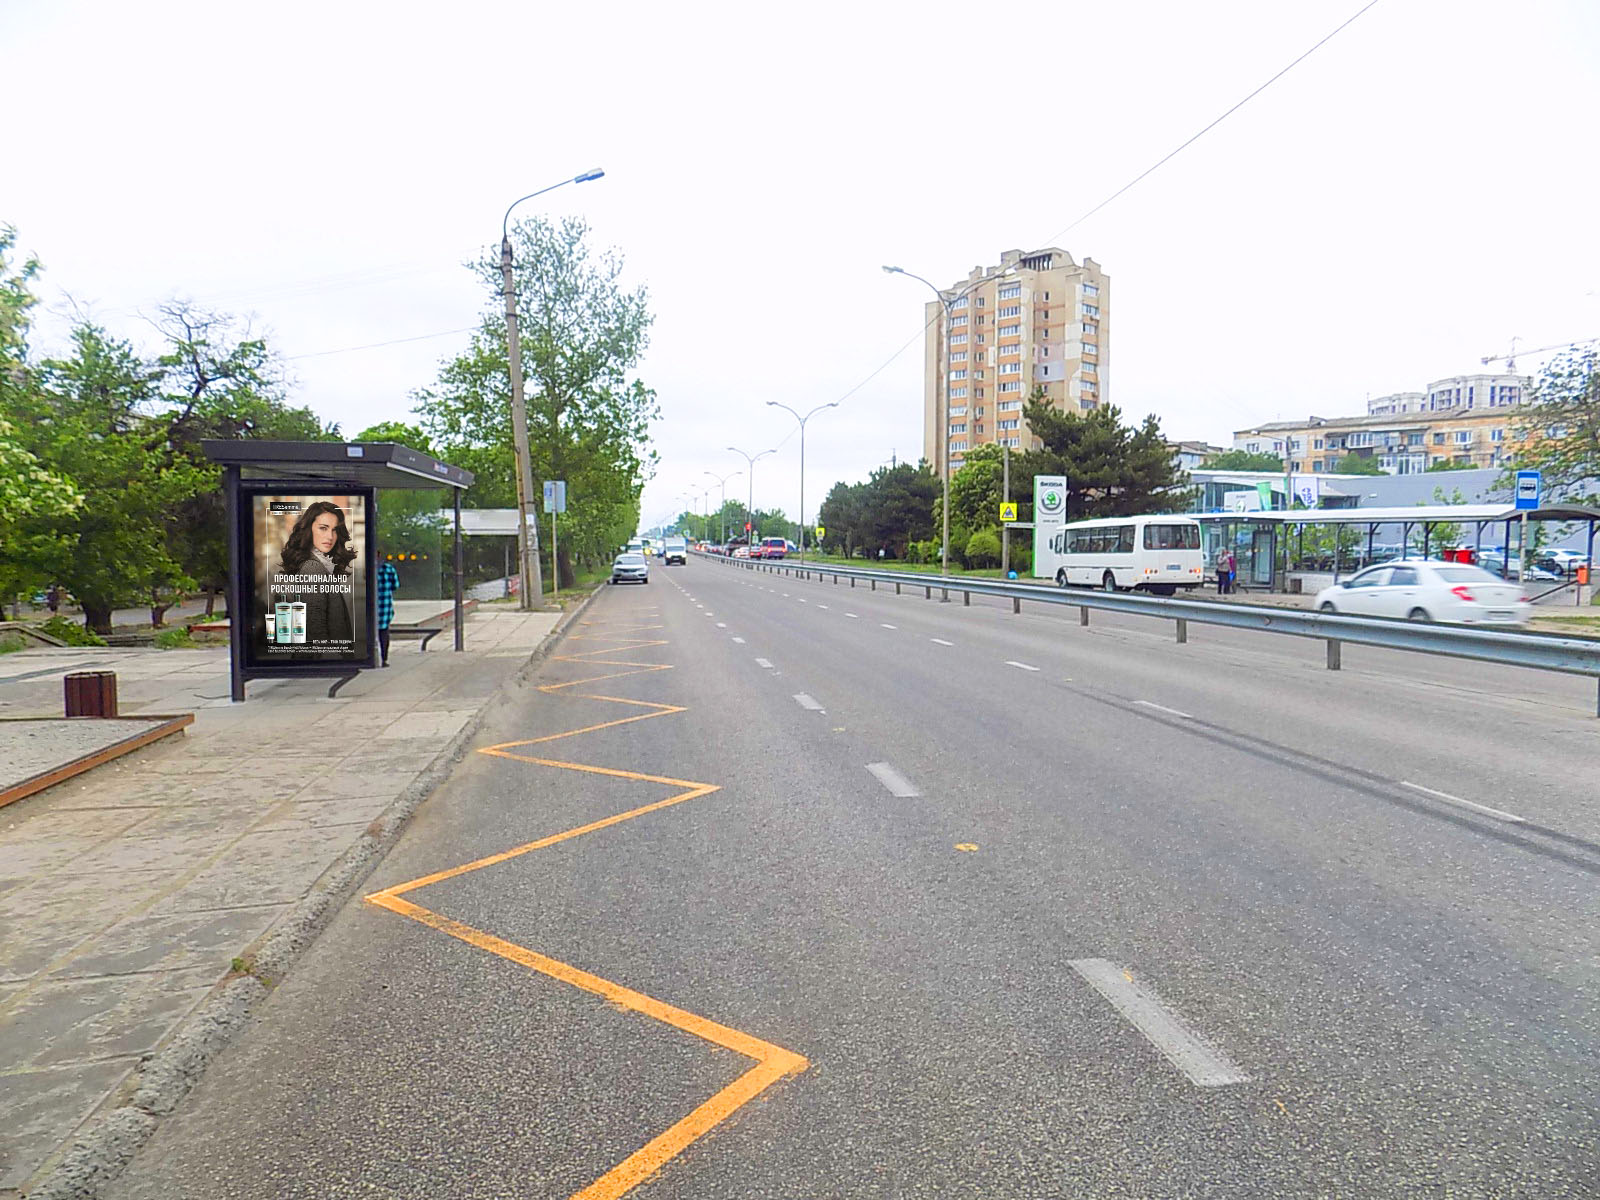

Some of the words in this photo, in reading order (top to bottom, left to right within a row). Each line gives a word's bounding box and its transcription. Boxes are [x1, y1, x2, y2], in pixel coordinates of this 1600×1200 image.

[274, 574, 348, 583] ПРОФЕССИОНАЛЬНО
[270, 584, 318, 593] РОСКОШНЫЕ
[319, 584, 351, 593] ВОЛОСЫ
